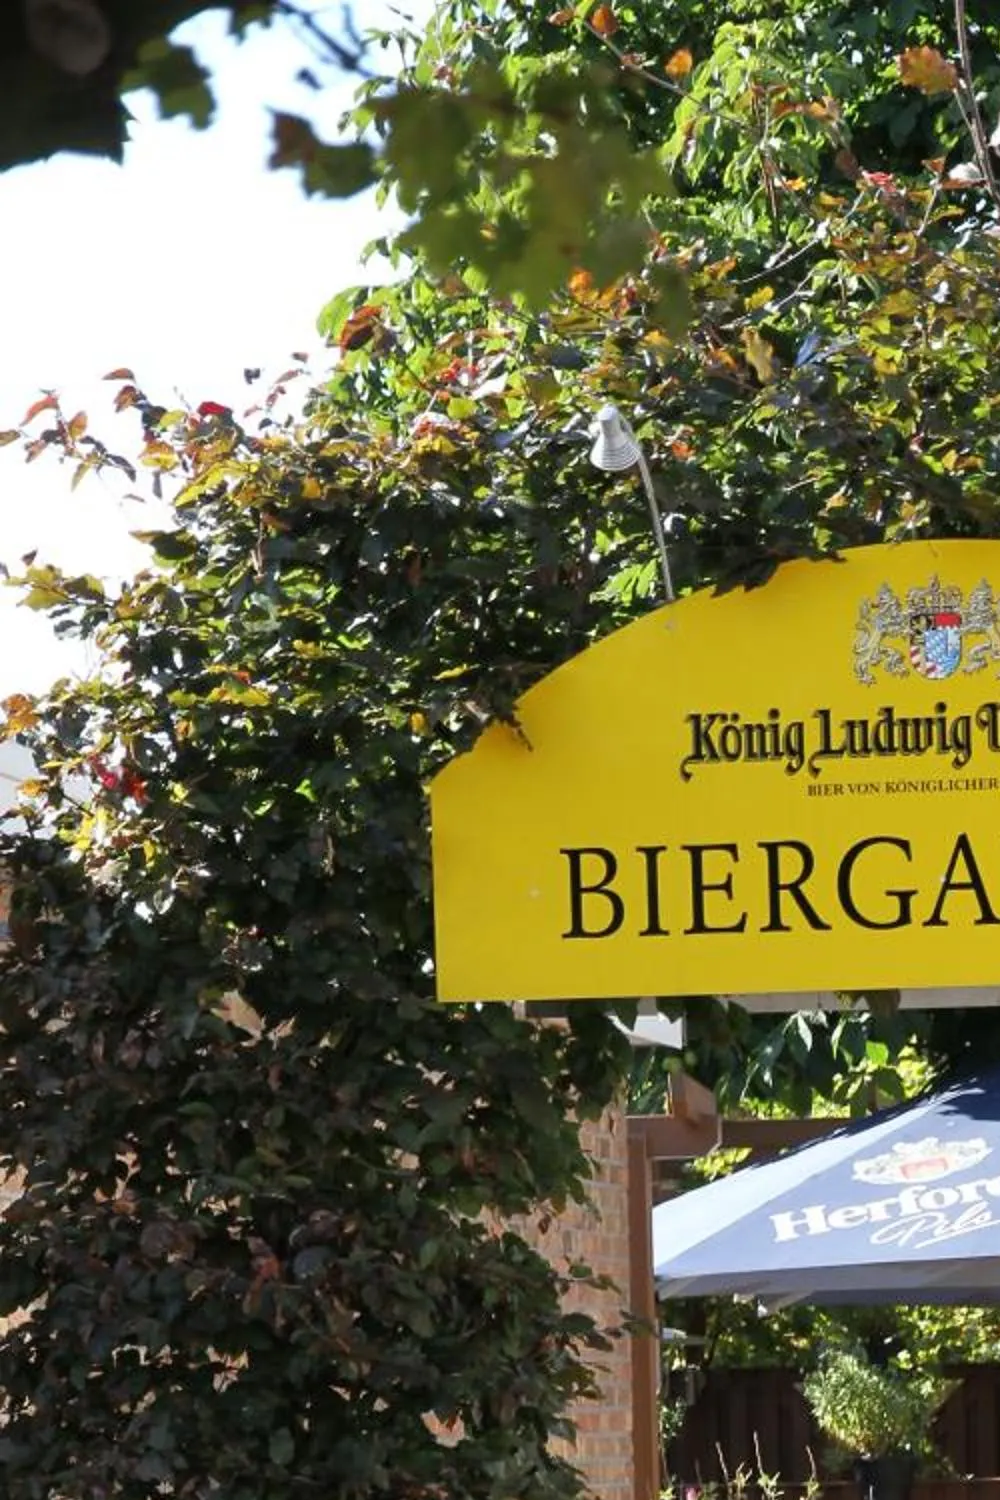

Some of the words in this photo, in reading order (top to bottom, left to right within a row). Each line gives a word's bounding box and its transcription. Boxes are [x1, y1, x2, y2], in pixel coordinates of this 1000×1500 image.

[680, 708, 805, 783] König
[808, 701, 972, 779] Ludwig
[807, 783, 845, 797] BIER
[847, 781, 880, 796] VON
[885, 776, 999, 795] KÖNIGLICHER
